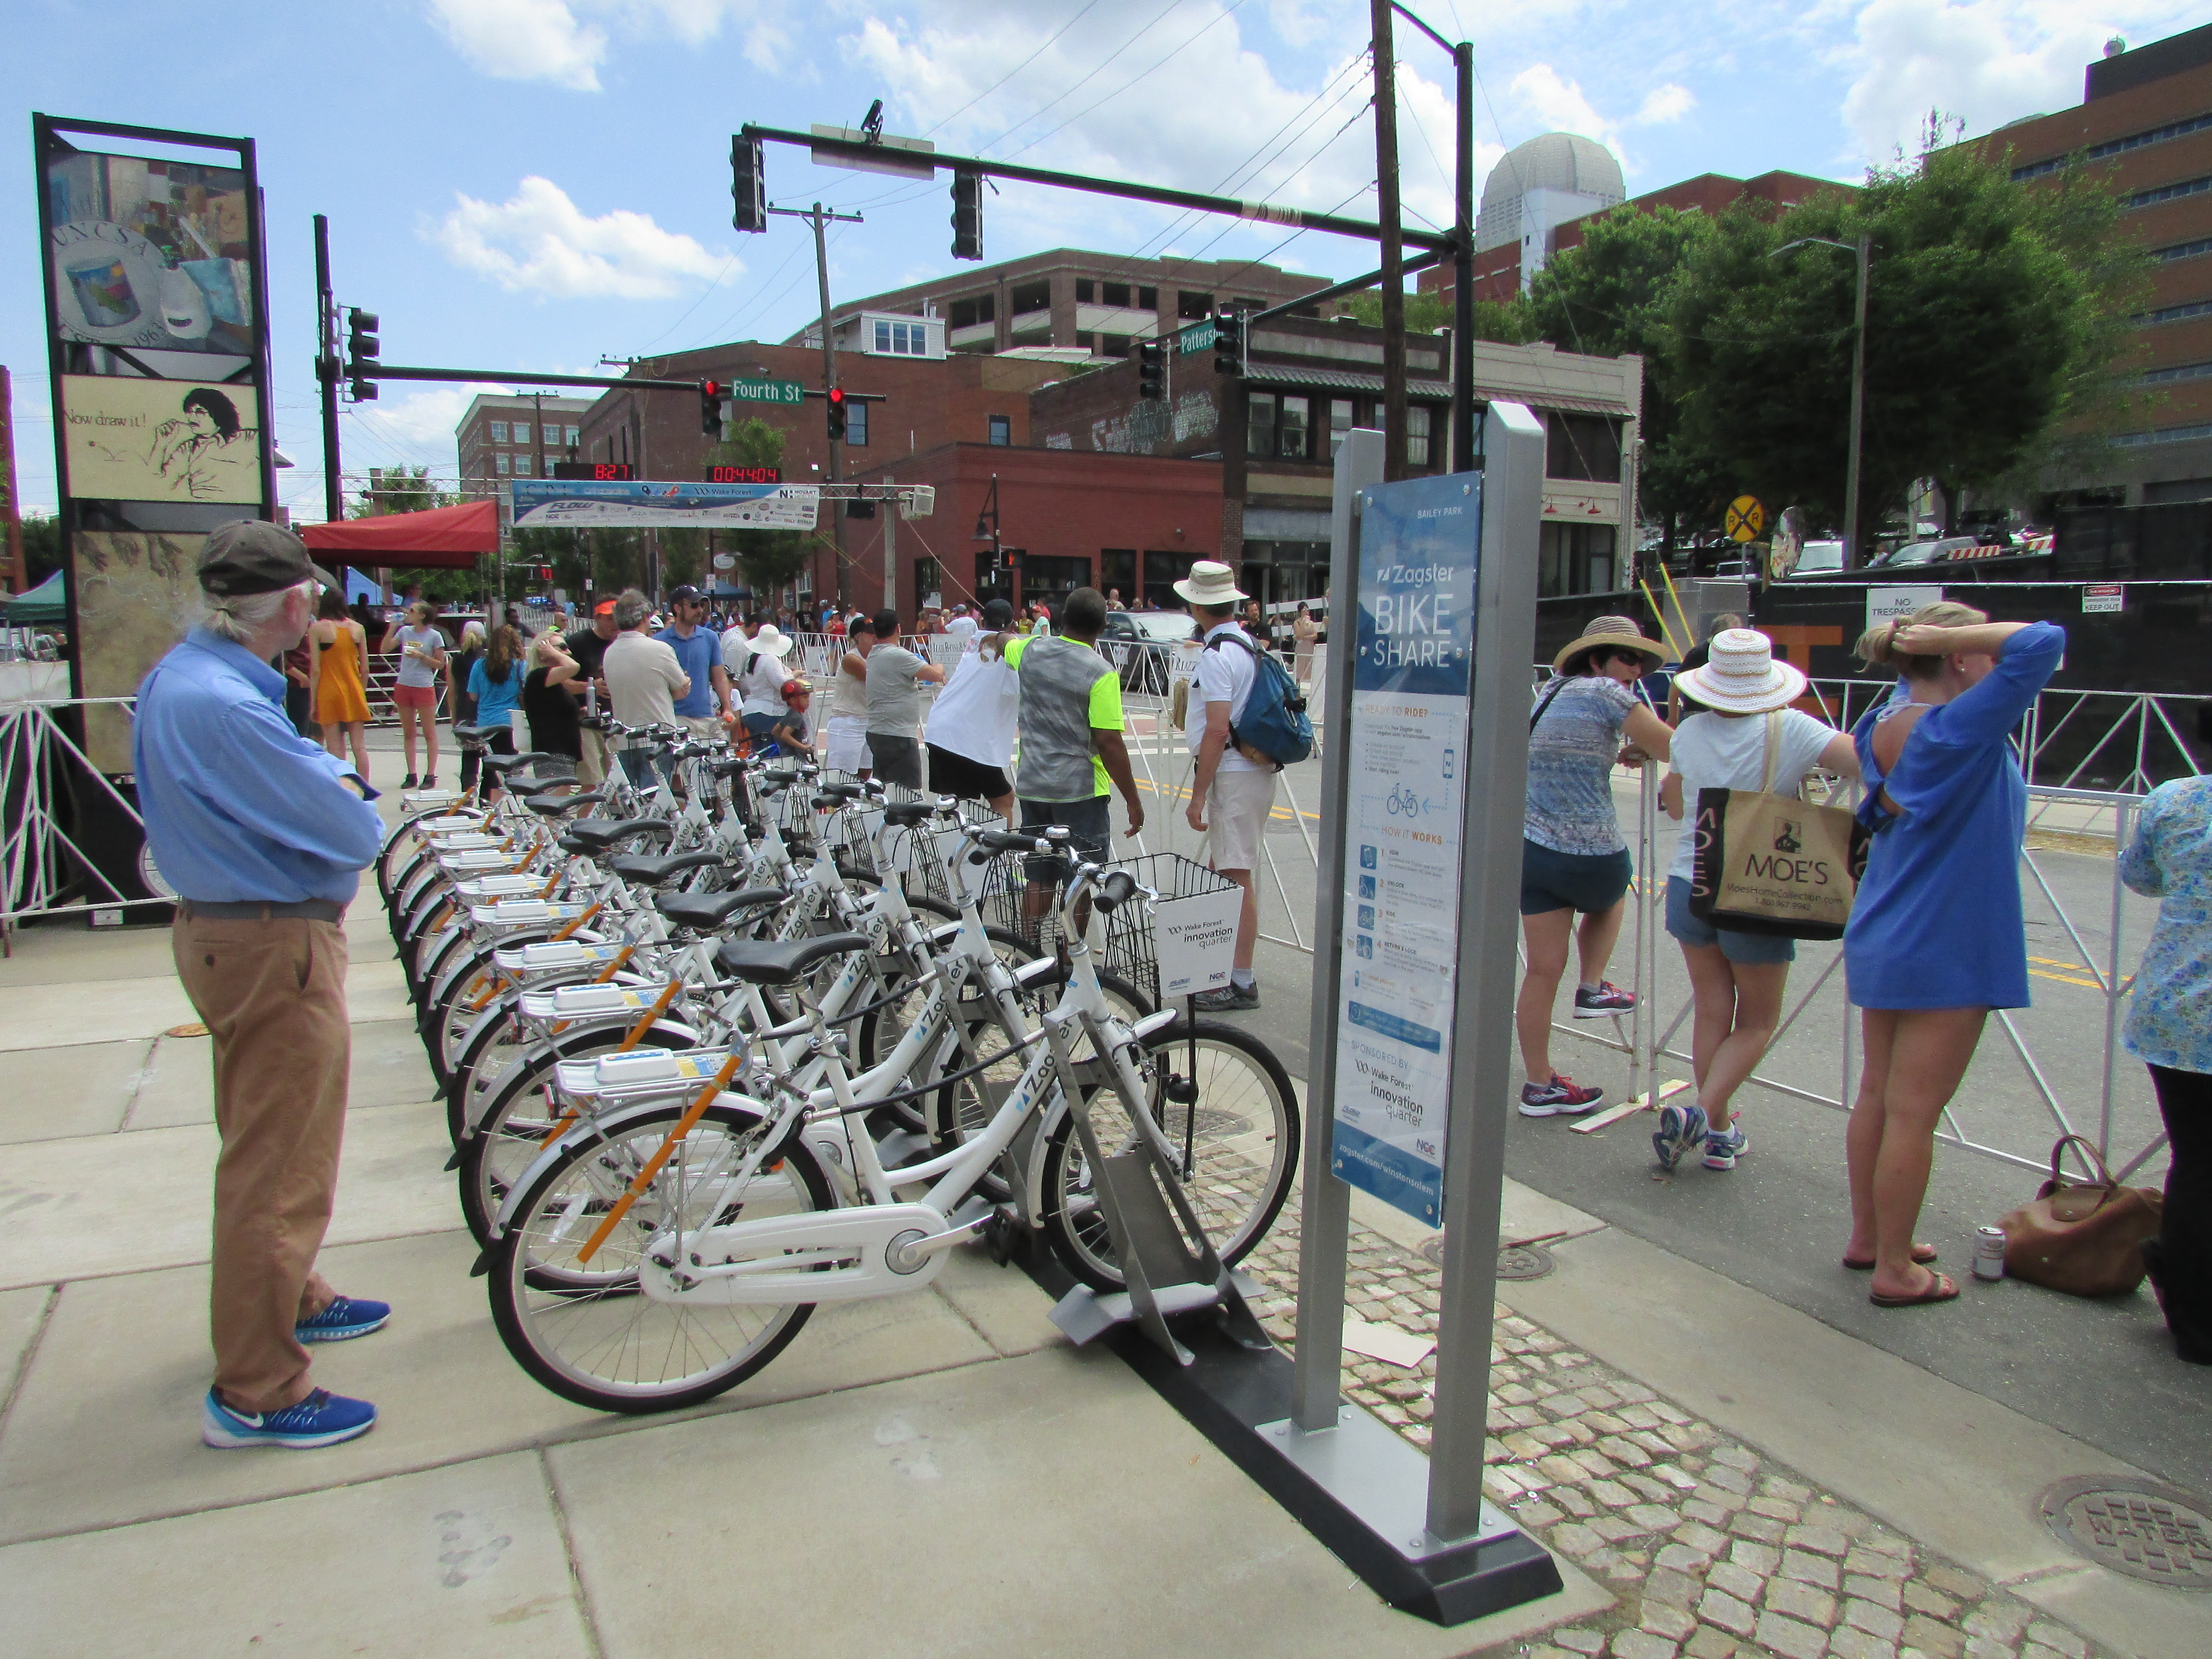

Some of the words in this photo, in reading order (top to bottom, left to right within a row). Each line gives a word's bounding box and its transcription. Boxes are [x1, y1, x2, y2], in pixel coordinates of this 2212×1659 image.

[733, 380, 779, 400] Fourth
[785, 385, 800, 401] St
[64, 409, 93, 424] Now
[96, 411, 127, 426] draw
[595, 464, 628, 479] 8:27
[714, 467, 777, 482] 00:44:04
[1418, 509, 1442, 519] BAILEY
[1444, 506, 1463, 517] PARK
[1393, 563, 1454, 589] Zagster
[1374, 593, 1454, 635] BIKE
[1872, 607, 1916, 615] TRESPASS
[1373, 639, 1451, 668] SHARE
[1365, 705, 1389, 715] READY
[1392, 706, 1402, 716] TO
[1405, 707, 1428, 718] RIDE?
[1382, 826, 1401, 837] HOW
[1402, 830, 1410, 838] IT
[1411, 830, 1443, 845] WORKS
[1744, 853, 1828, 885] MOE'S
[1387, 880, 1405, 889] UNLOCK
[1185, 923, 1201, 931] Wake
[1202, 920, 1222, 928] Forest
[1184, 927, 1233, 943] innovation
[1199, 936, 1233, 950] quarter
[1384, 941, 1400, 950] RETURN
[1351, 1040, 1397, 1066] SPONSORED
[1398, 1058, 1409, 1070] BY
[1371, 1067, 1389, 1082] Wake
[1390, 1075, 1412, 1091] Forest
[1370, 1081, 1423, 1116] innovation
[1385, 1104, 1422, 1128] quarter
[1339, 1143, 1434, 1196] zagster.com/winstonsalem
